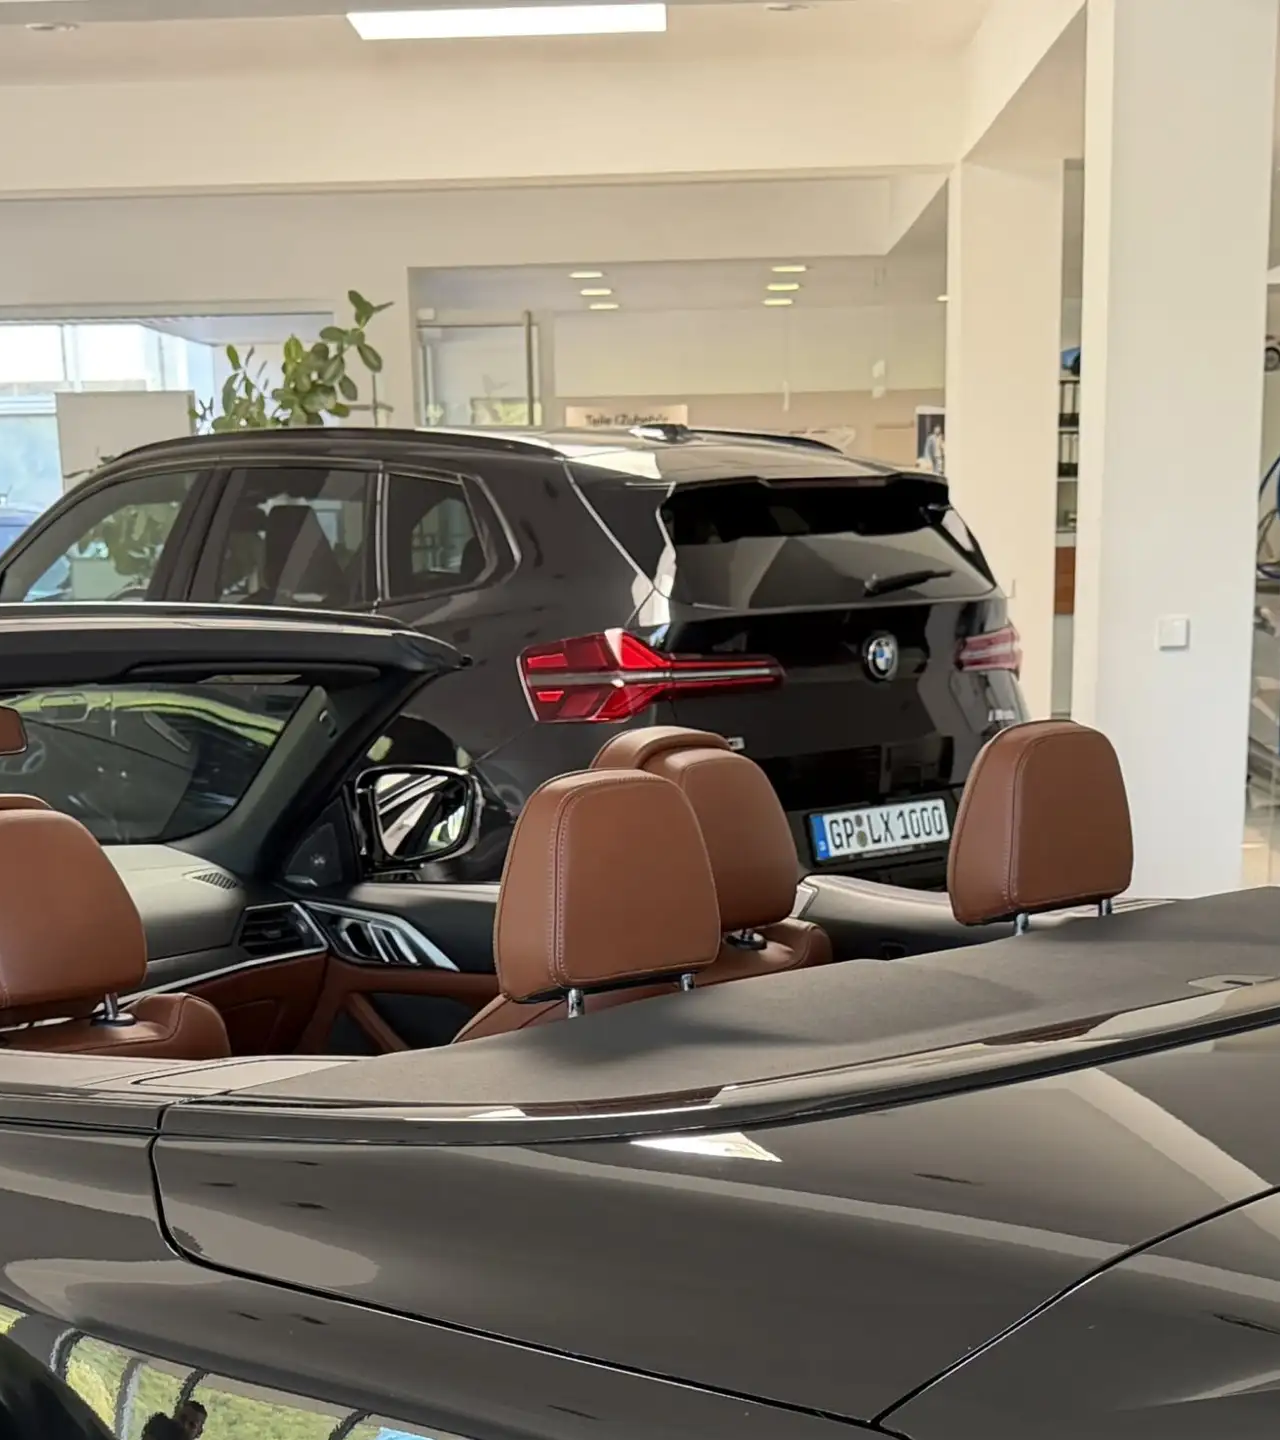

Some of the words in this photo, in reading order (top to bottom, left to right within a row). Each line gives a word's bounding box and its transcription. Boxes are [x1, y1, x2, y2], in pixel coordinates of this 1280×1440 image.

[828, 818, 855, 850] GP
[866, 812, 895, 844] LX
[896, 806, 944, 840] 1000
